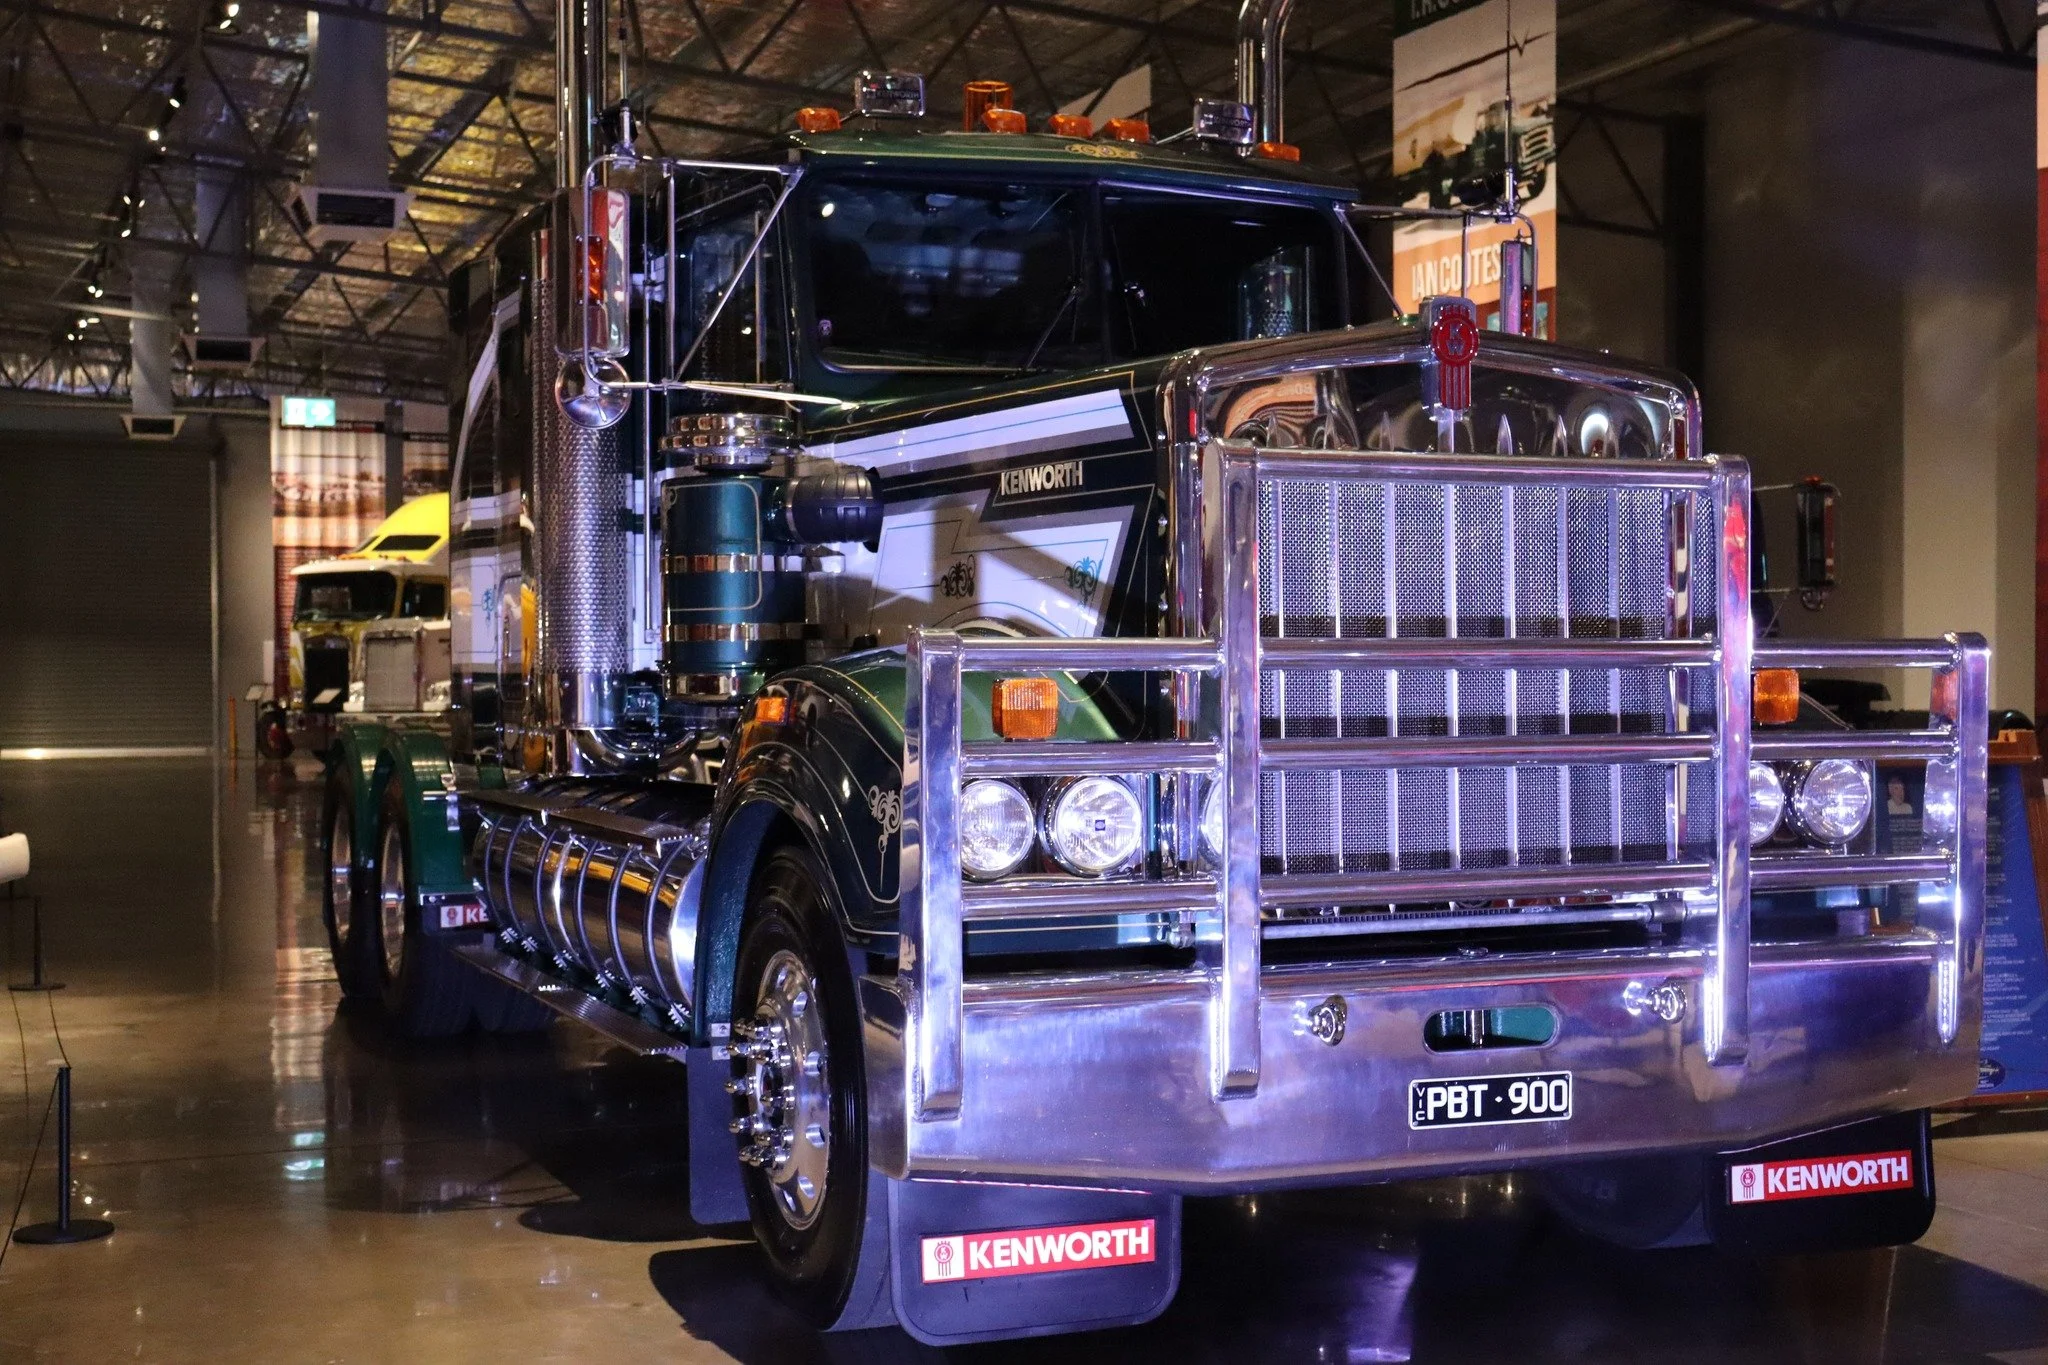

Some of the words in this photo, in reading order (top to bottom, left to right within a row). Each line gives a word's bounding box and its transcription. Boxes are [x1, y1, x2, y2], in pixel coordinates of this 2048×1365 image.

[1001, 461, 1083, 496] KENWORTH
[1767, 1156, 1909, 1194] KENWORTH
[969, 1226, 1149, 1271] KENWORTH
